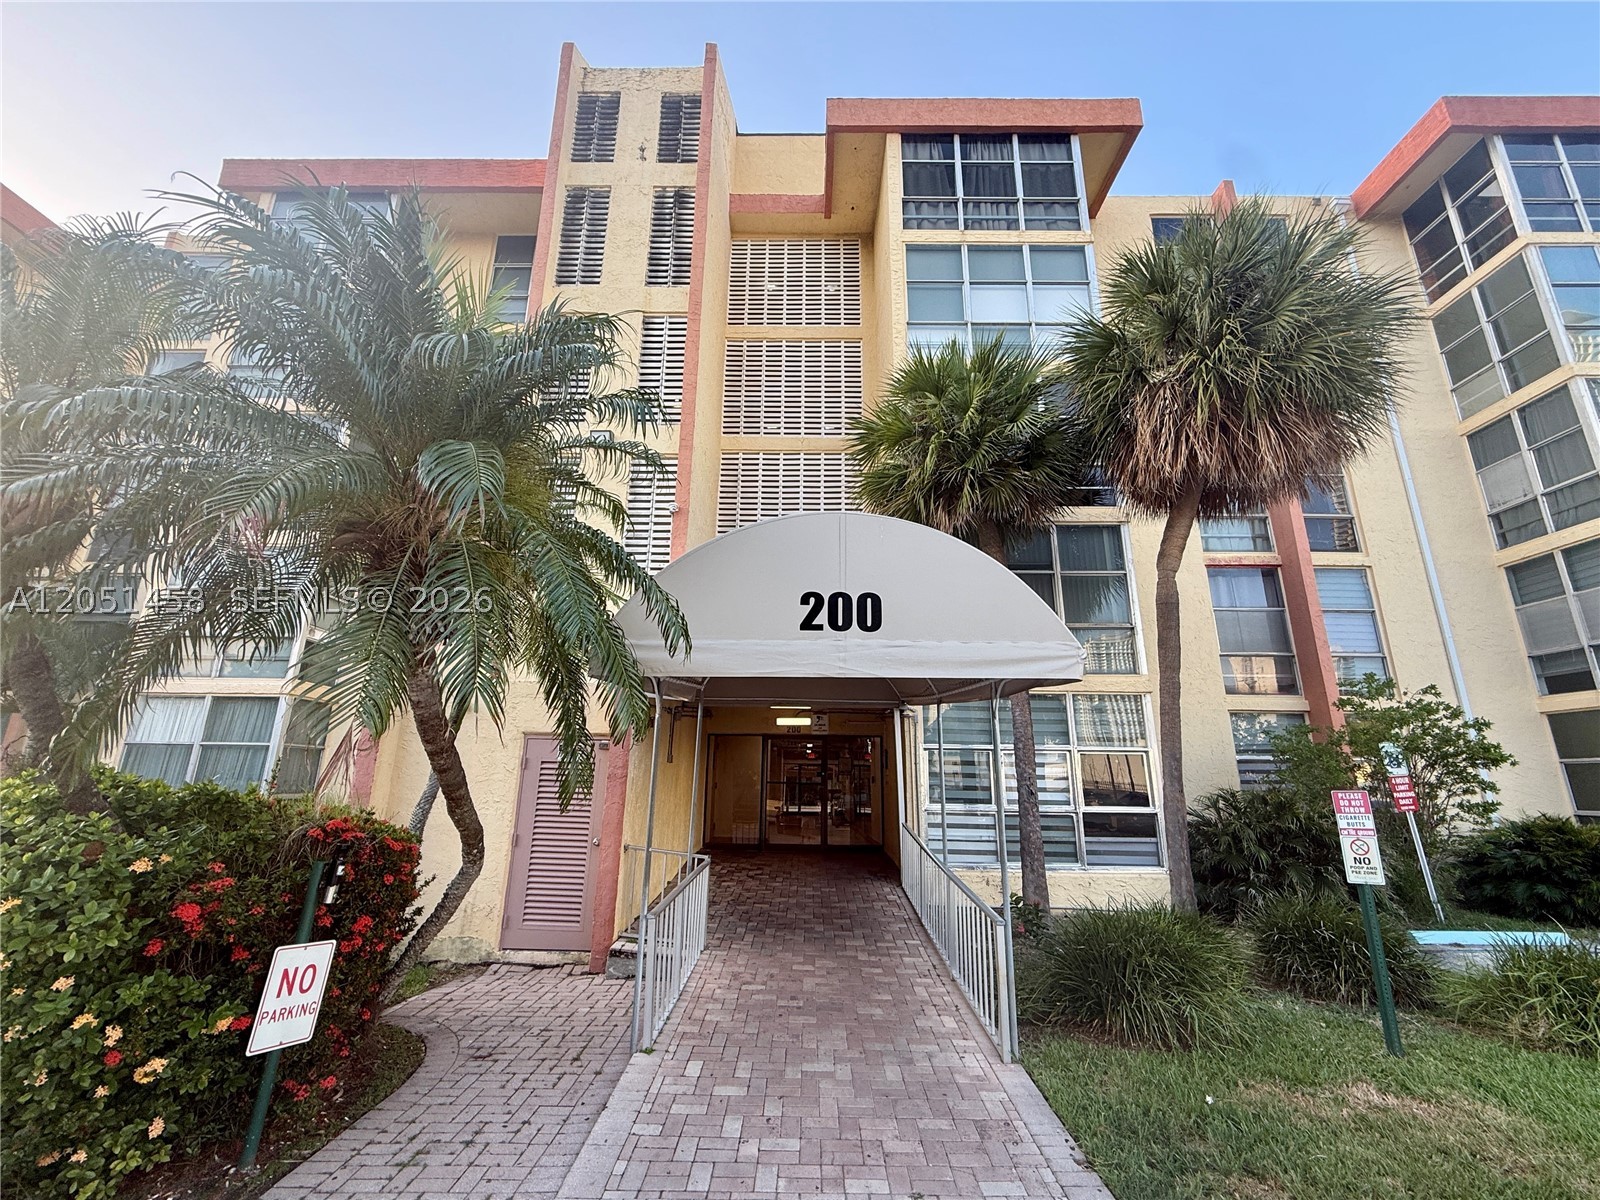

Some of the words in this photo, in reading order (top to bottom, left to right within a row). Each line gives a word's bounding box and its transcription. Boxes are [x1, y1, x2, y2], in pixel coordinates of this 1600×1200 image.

[800, 591, 882, 632] 200
[786, 726, 801, 734] 200
[1353, 857, 1371, 865] NO
[276, 963, 317, 999] NO
[259, 1001, 317, 1026] PARKING
